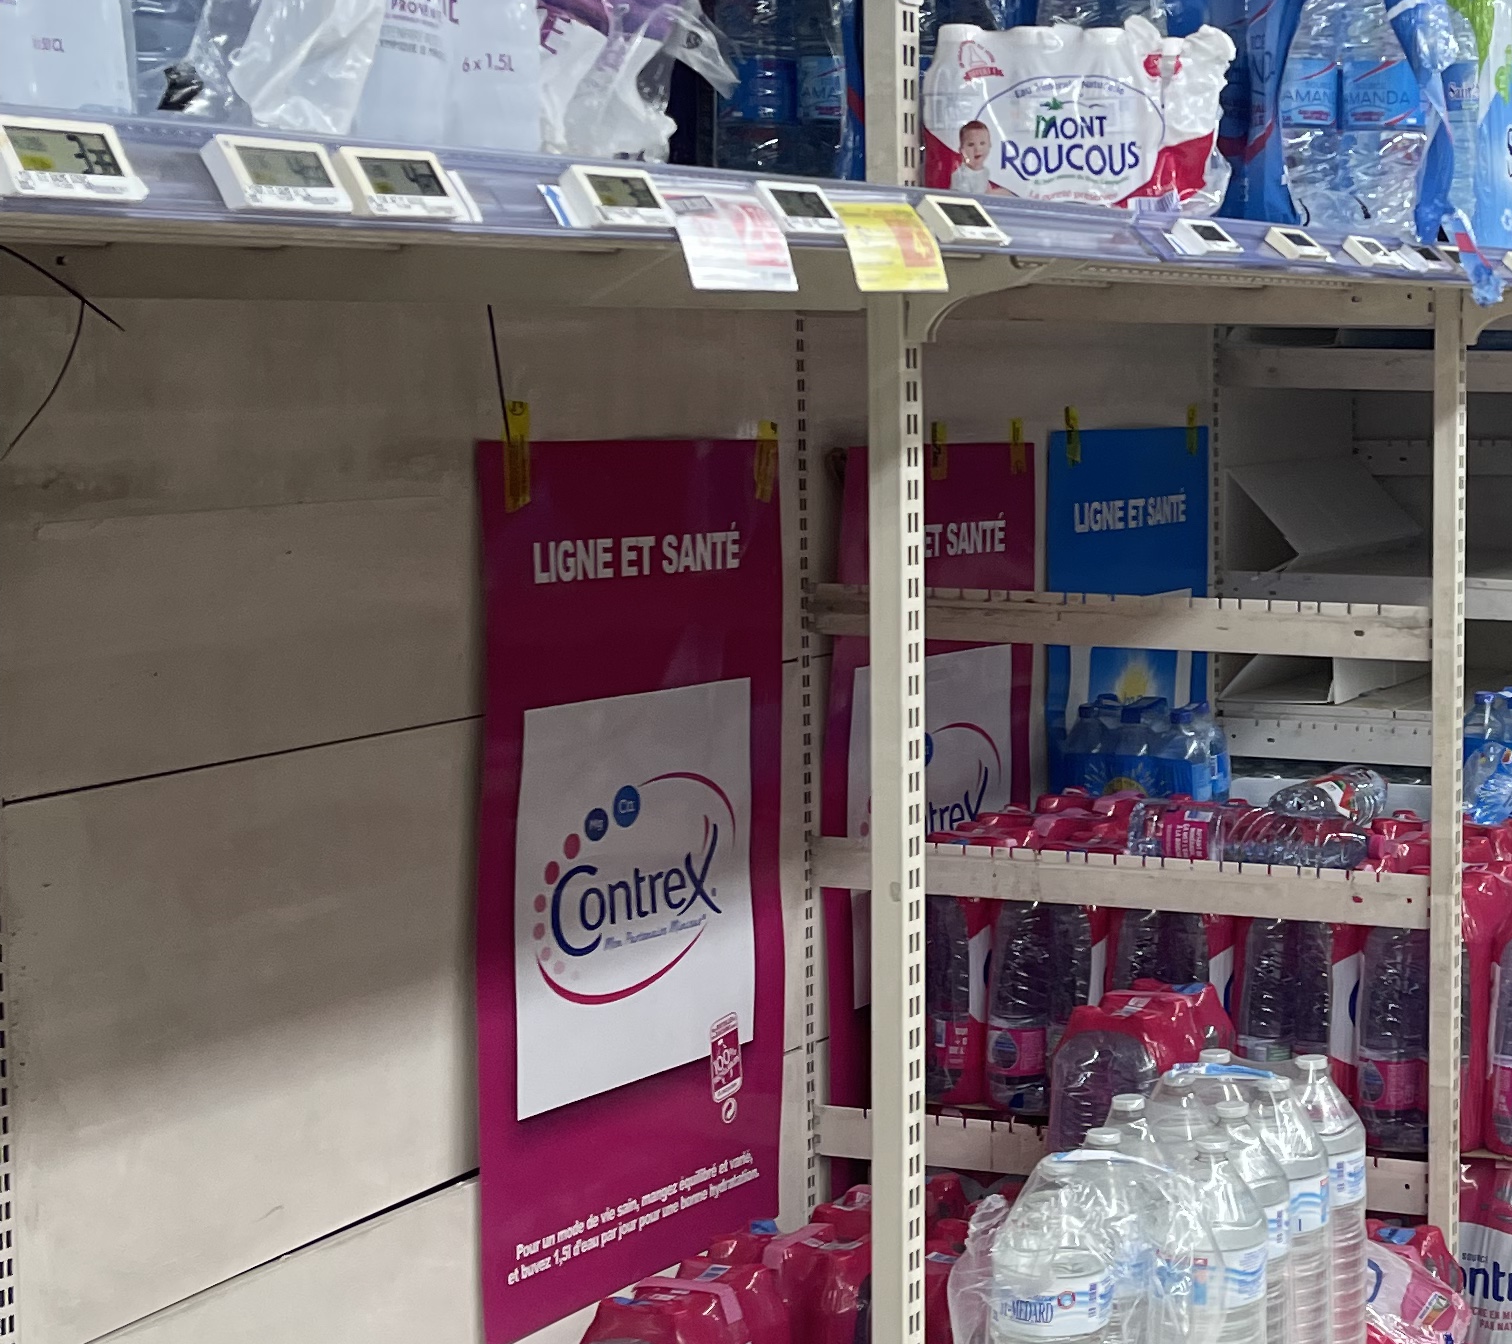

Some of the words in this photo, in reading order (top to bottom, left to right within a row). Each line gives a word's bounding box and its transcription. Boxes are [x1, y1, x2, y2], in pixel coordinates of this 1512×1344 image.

[1034, 115, 1107, 139] MONT
[1000, 140, 1142, 182] ROUCOUS
[1074, 501, 1125, 533] LIGNE
[1127, 503, 1146, 529] ET
[1147, 487, 1187, 524] SANTÉ
[533, 537, 613, 584] LIGNE
[621, 535, 656, 577] ET
[662, 522, 740, 574] SANTÉ
[946, 512, 1006, 556] SANTÉ
[516, 1239, 541, 1260] Pour
[542, 1233, 556, 1250] un
[557, 1220, 585, 1242] mode
[586, 1214, 599, 1230] de
[601, 1207, 616, 1224] vie
[641, 1182, 678, 1207] mangez
[718, 1159, 729, 1175] et
[507, 1267, 520, 1286] et
[521, 1256, 552, 1279] buvez
[601, 1227, 618, 1248] par
[618, 1218, 638, 1240] jour
[638, 1209, 661, 1232] pour
